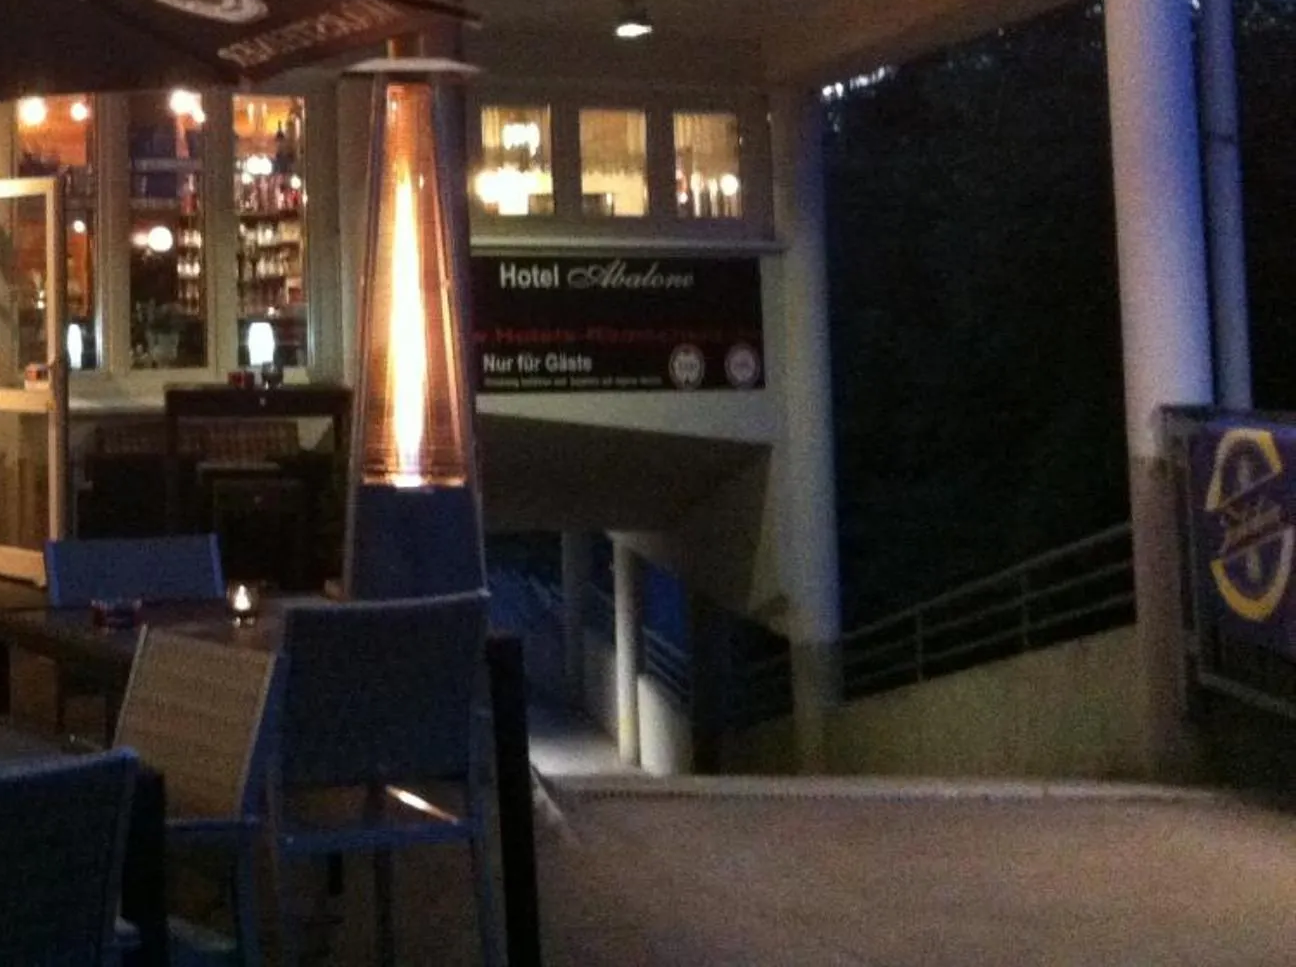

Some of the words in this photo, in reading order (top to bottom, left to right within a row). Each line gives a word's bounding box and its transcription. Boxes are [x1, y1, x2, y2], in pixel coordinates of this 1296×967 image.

[499, 262, 560, 289] Hotel
[567, 258, 695, 290] Abalone
[483, 352, 514, 374] Nur
[517, 351, 541, 373] für
[545, 351, 593, 373] Gäste
